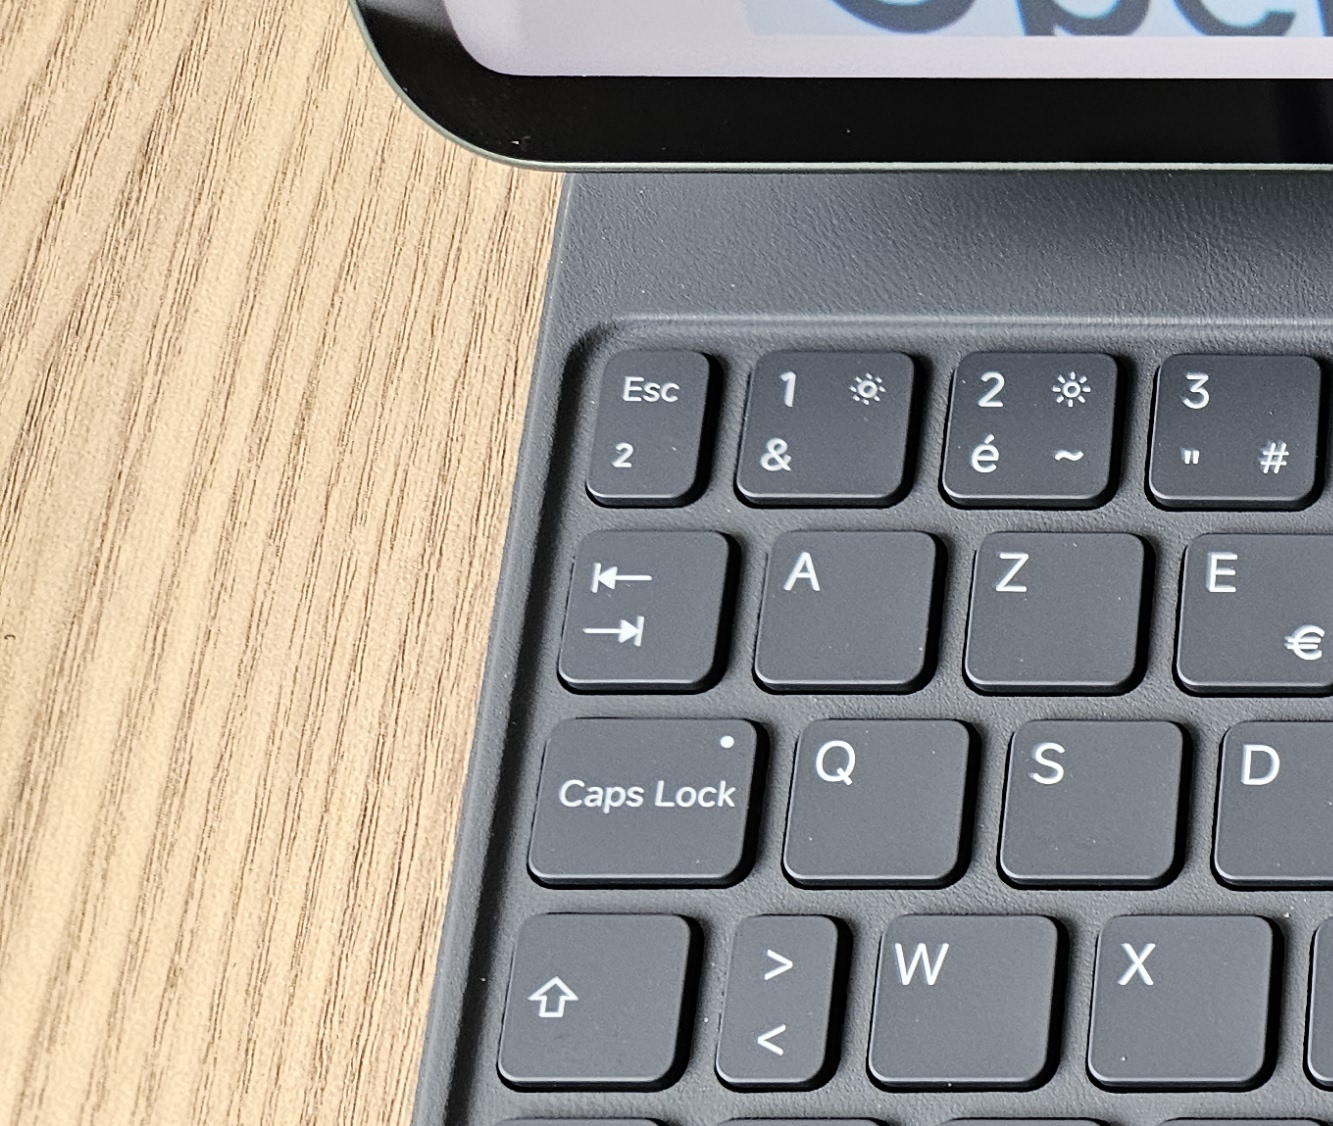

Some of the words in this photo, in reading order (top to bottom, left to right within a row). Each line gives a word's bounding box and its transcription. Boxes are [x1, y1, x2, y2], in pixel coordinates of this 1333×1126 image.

[622, 376, 680, 403] Esc
[780, 371, 797, 408] 1
[977, 371, 1005, 408] 2
[1182, 372, 1210, 410] 3
[760, 437, 792, 472] &
[971, 433, 1000, 473] é
[1259, 442, 1290, 474] #
[783, 551, 821, 592] A
[995, 552, 1030, 593] Z
[1206, 551, 1238, 593] E
[1284, 624, 1326, 661] €
[815, 740, 856, 786] Q
[1030, 742, 1066, 785] S
[1241, 744, 1281, 786] D
[558, 779, 645, 814] Caps
[654, 779, 736, 808] Lock
[764, 949, 794, 981] >
[894, 942, 950, 986] W
[1117, 942, 1156, 986] X
[757, 1024, 787, 1056] <
